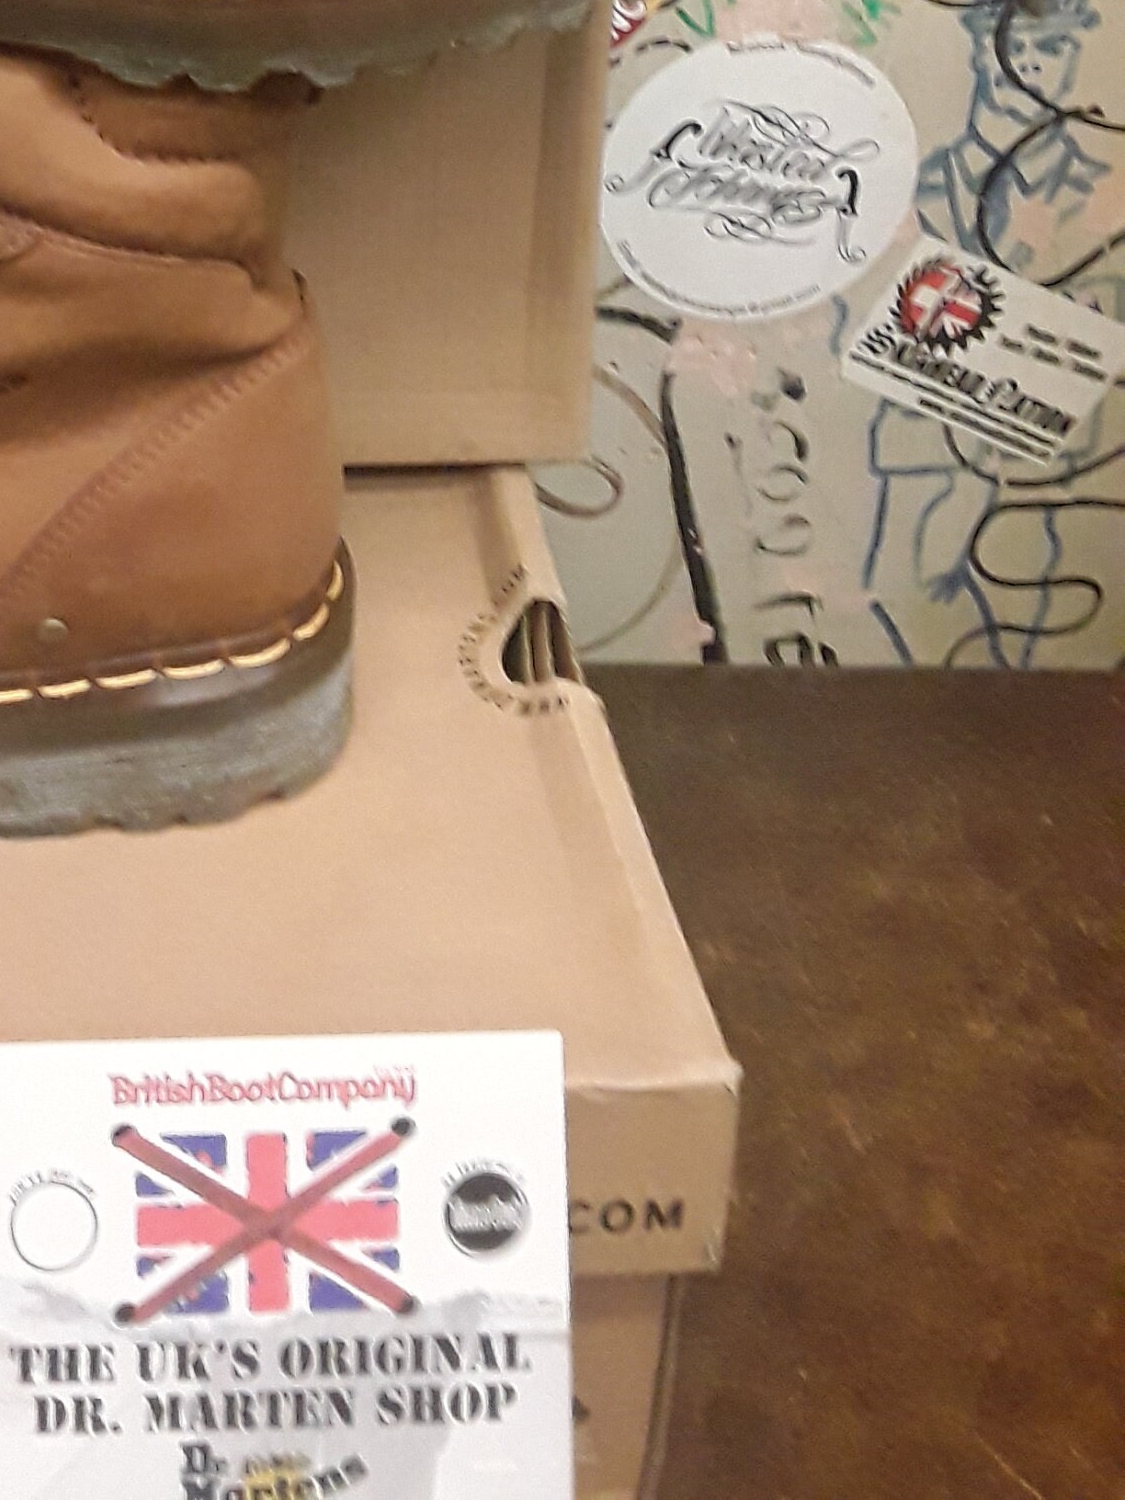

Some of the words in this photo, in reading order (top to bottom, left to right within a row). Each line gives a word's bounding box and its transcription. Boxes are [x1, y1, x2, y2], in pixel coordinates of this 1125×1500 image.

[108, 1066, 416, 1111] BritishBootCompany
[9, 1343, 117, 1384] THE
[134, 1338, 263, 1383] UK'S
[278, 1331, 533, 1381] ORIGINAL
[33, 1396, 122, 1435] DR.
[143, 1389, 356, 1434] MARTEN
[375, 1382, 517, 1426] SHOP
